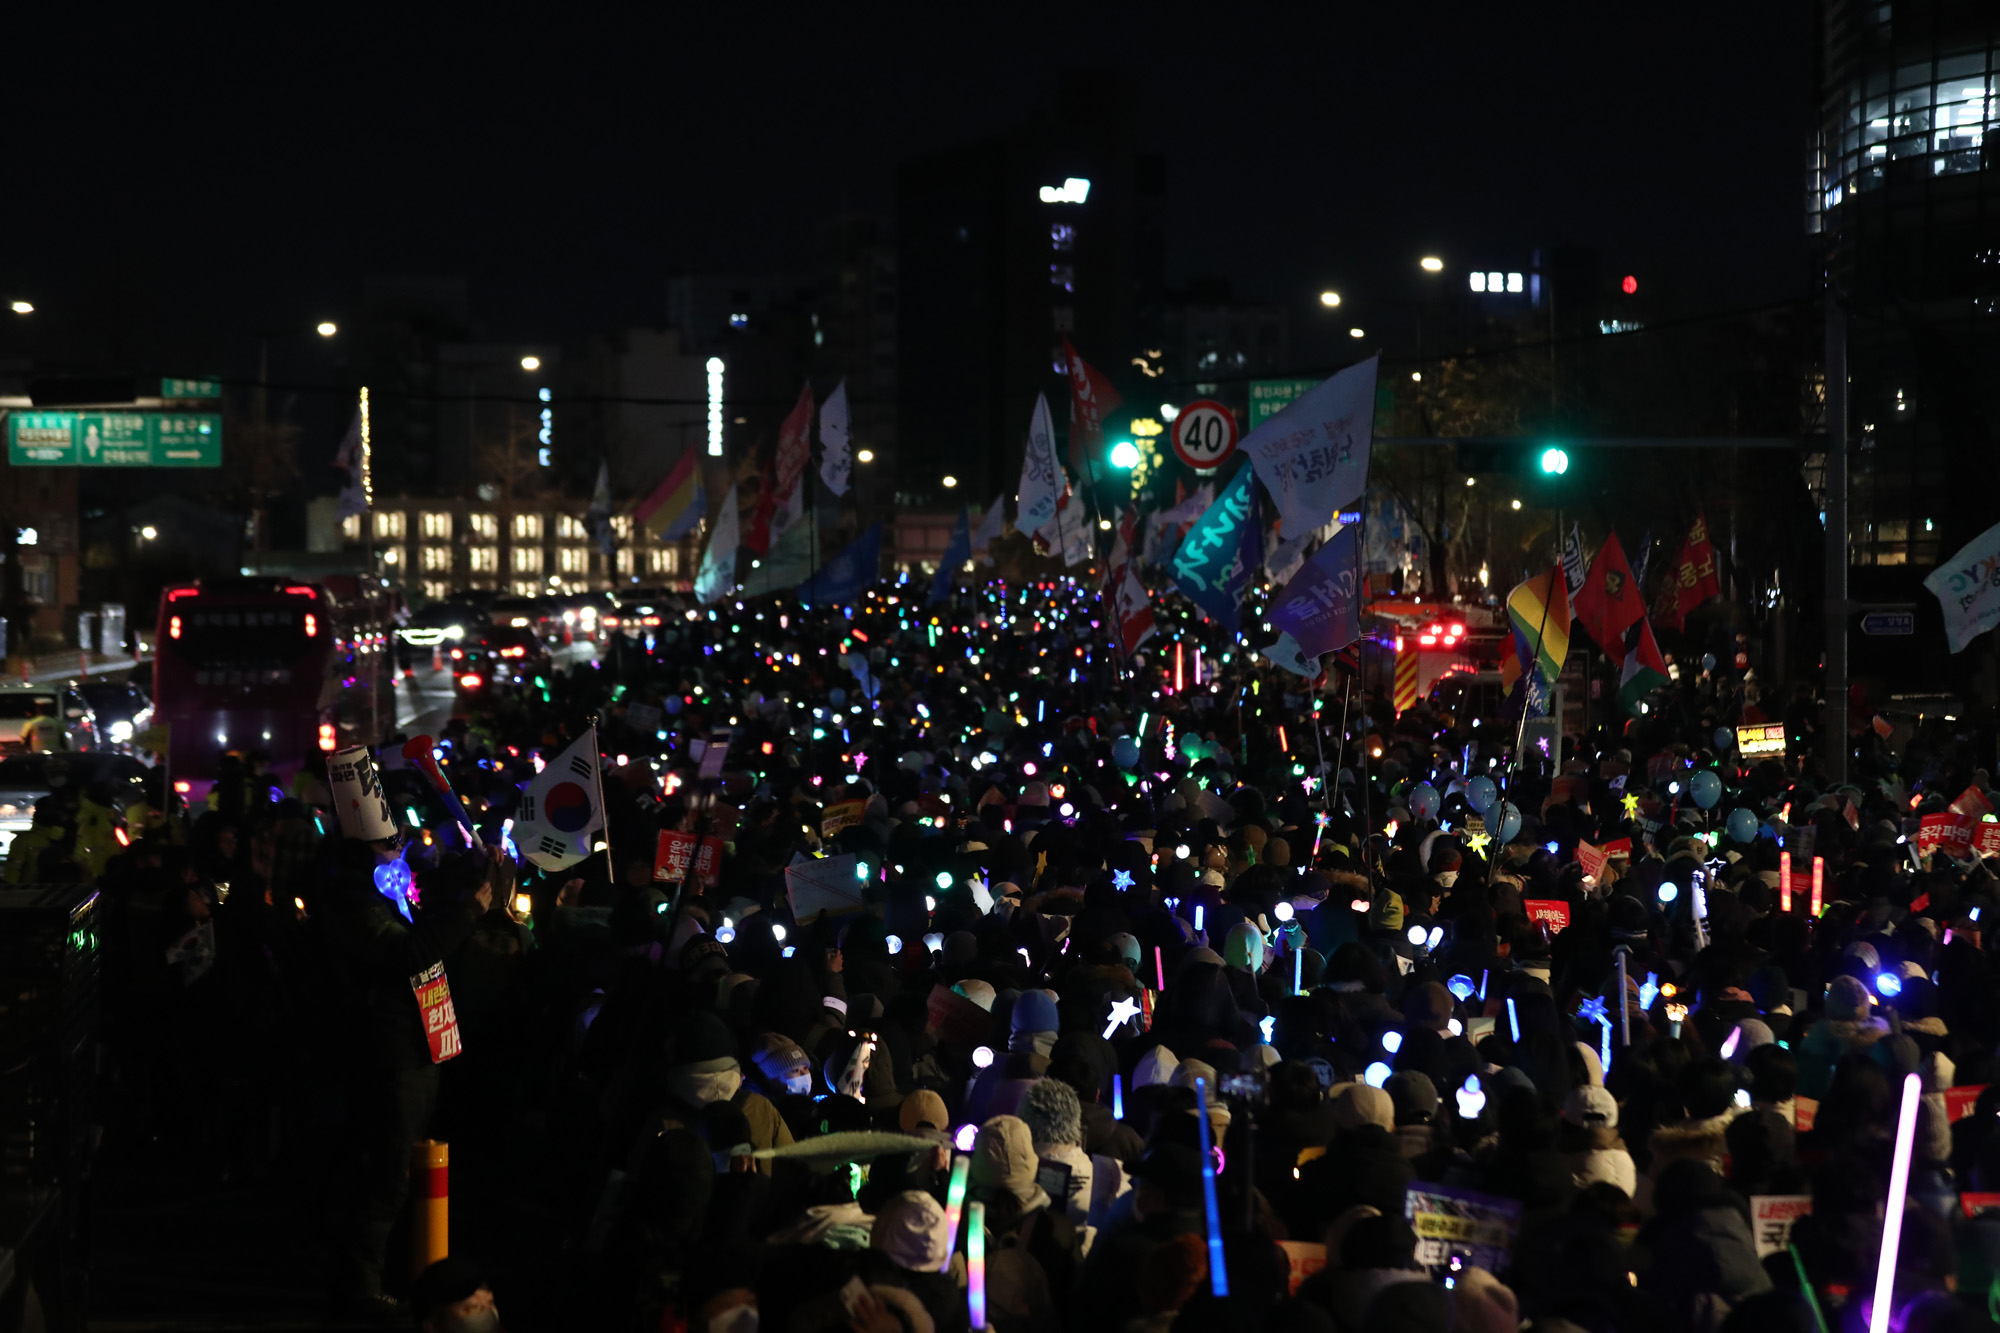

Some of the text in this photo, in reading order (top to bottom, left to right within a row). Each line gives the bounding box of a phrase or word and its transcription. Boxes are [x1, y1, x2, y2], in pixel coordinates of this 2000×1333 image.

[1185, 416, 1223, 452] 40
[332, 769, 356, 783] 파면
[1920, 824, 1972, 845] 즉각 파면
[669, 839, 713, 861] 윤석을
